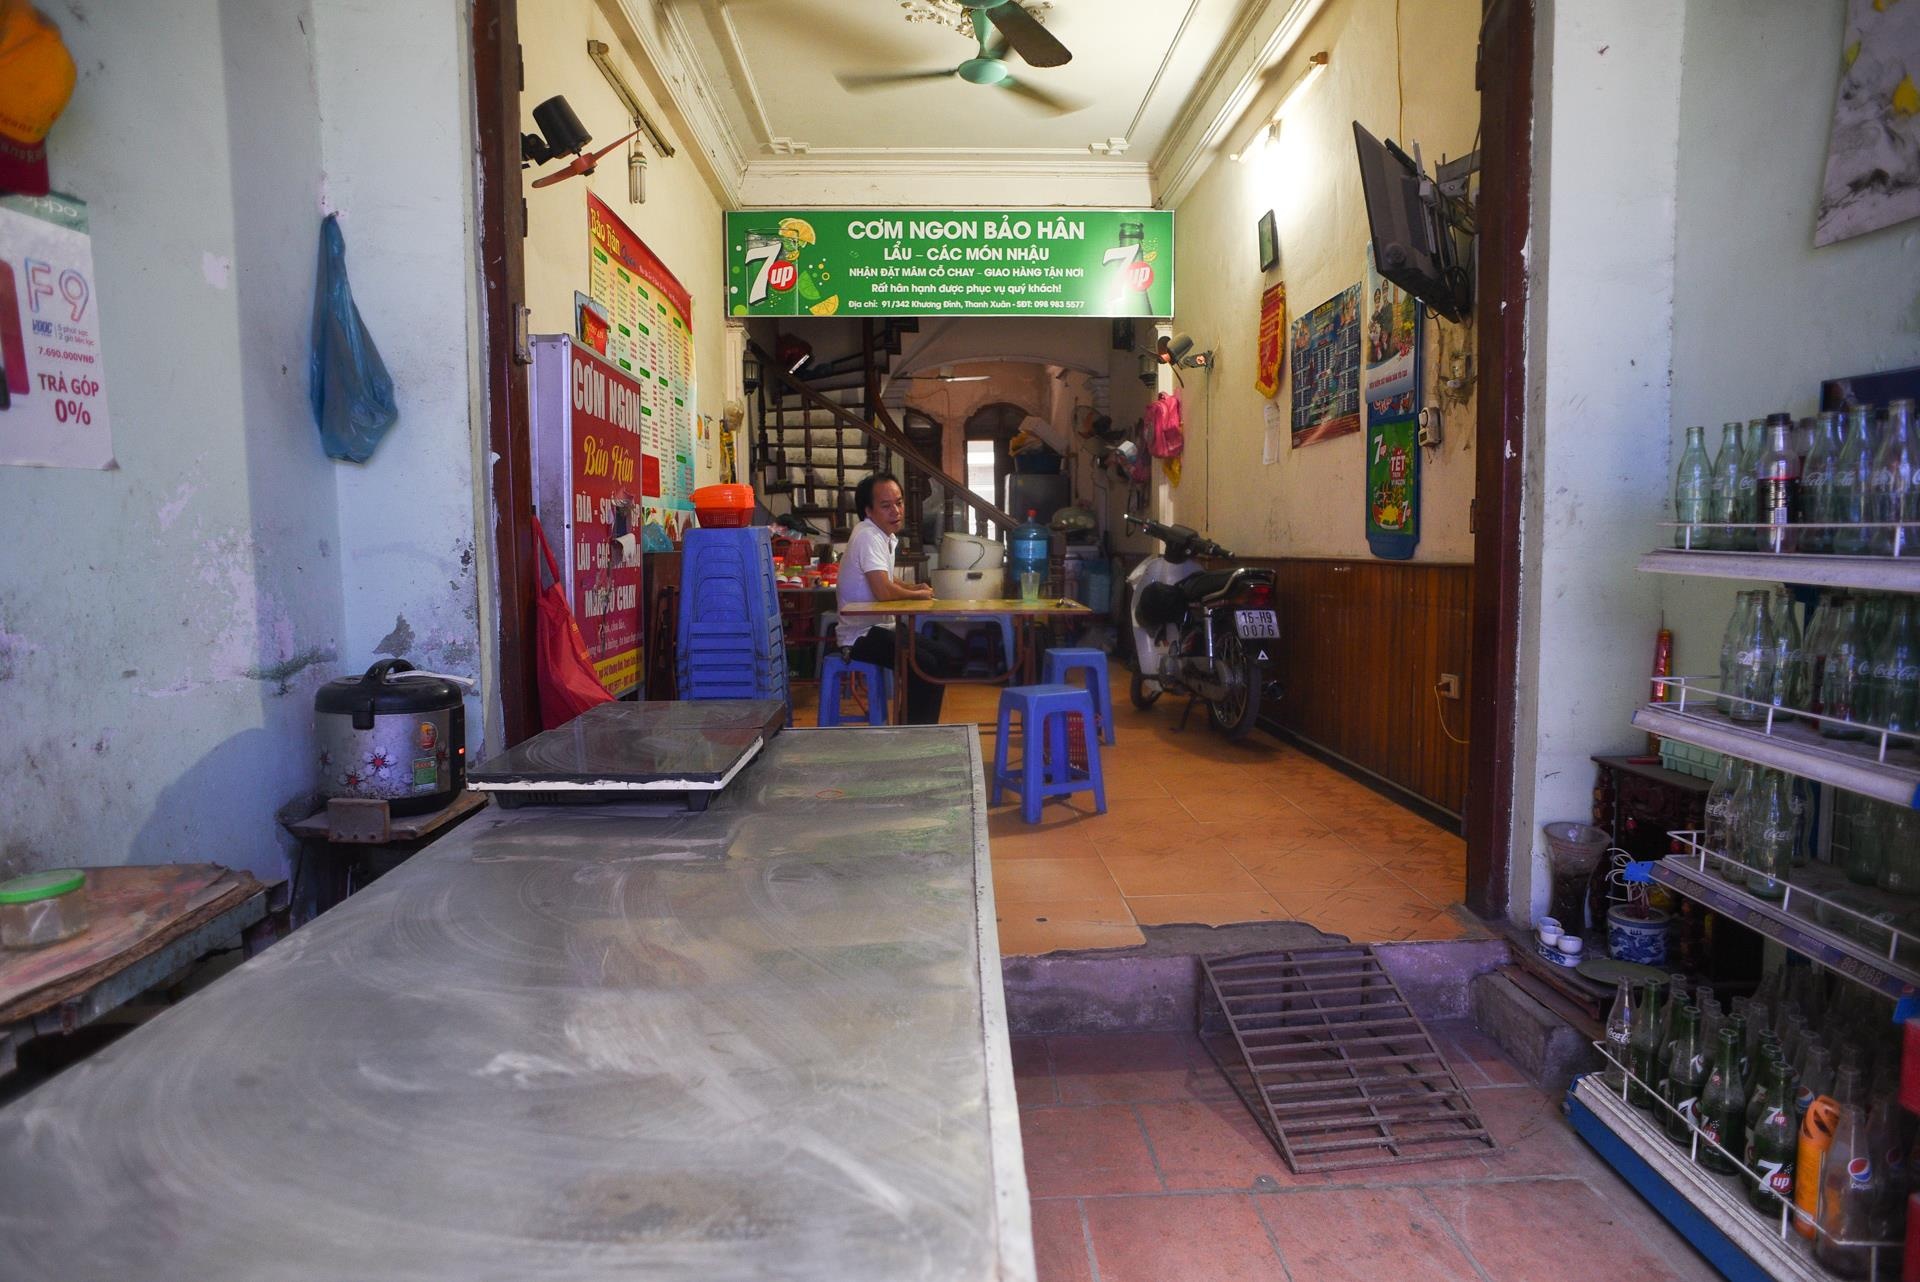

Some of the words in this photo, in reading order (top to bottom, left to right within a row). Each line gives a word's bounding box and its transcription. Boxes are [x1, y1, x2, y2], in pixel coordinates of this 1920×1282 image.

[848, 218, 903, 240] CƠM
[909, 221, 978, 240] NGON
[984, 214, 1032, 240] BẢO
[1037, 216, 1085, 240] HÂN
[884, 241, 912, 261] LẨU
[926, 244, 962, 261] CÁC
[966, 244, 1003, 261] MÓN
[1006, 244, 1049, 264] NHẬU
[849, 266, 878, 279] NHẬN
[880, 266, 900, 279] ĐẶT
[901, 266, 927, 277] MÂM
[947, 268, 975, 277] CHAY
[984, 268, 1010, 277] GIAO
[1012, 266, 1042, 278] HÀNG
[1044, 266, 1063, 279] TẬN
[1065, 267, 1084, 278] NƠI
[871, 282, 888, 293] Rất
[890, 283, 910, 293] hân
[911, 284, 937, 295] hạnh
[938, 284, 964, 295] được
[966, 284, 992, 295] phục
[994, 286, 1005, 295] vụ
[1007, 284, 1026, 294] quý
[1028, 283, 1062, 294] khách!
[848, 301, 863, 310] Địa
[881, 301, 910, 309] 91/342
[965, 301, 988, 309] Thanh
[989, 301, 1012, 309] Xuân
[1034, 301, 1049, 309] 098
[1050, 301, 1064, 309] 983
[1066, 301, 1085, 309] 5577
[37, 371, 68, 394] TRẢ
[70, 374, 99, 397] GÓP
[573, 358, 606, 420] CƠM
[608, 378, 640, 435] NGON
[55, 398, 91, 426] 0%
[583, 435, 609, 478] Bảo
[611, 445, 635, 485] Hân
[576, 490, 592, 523] ĐĨA
[616, 584, 637, 612] CHAY
[1242, 624, 1274, 637] 0076
